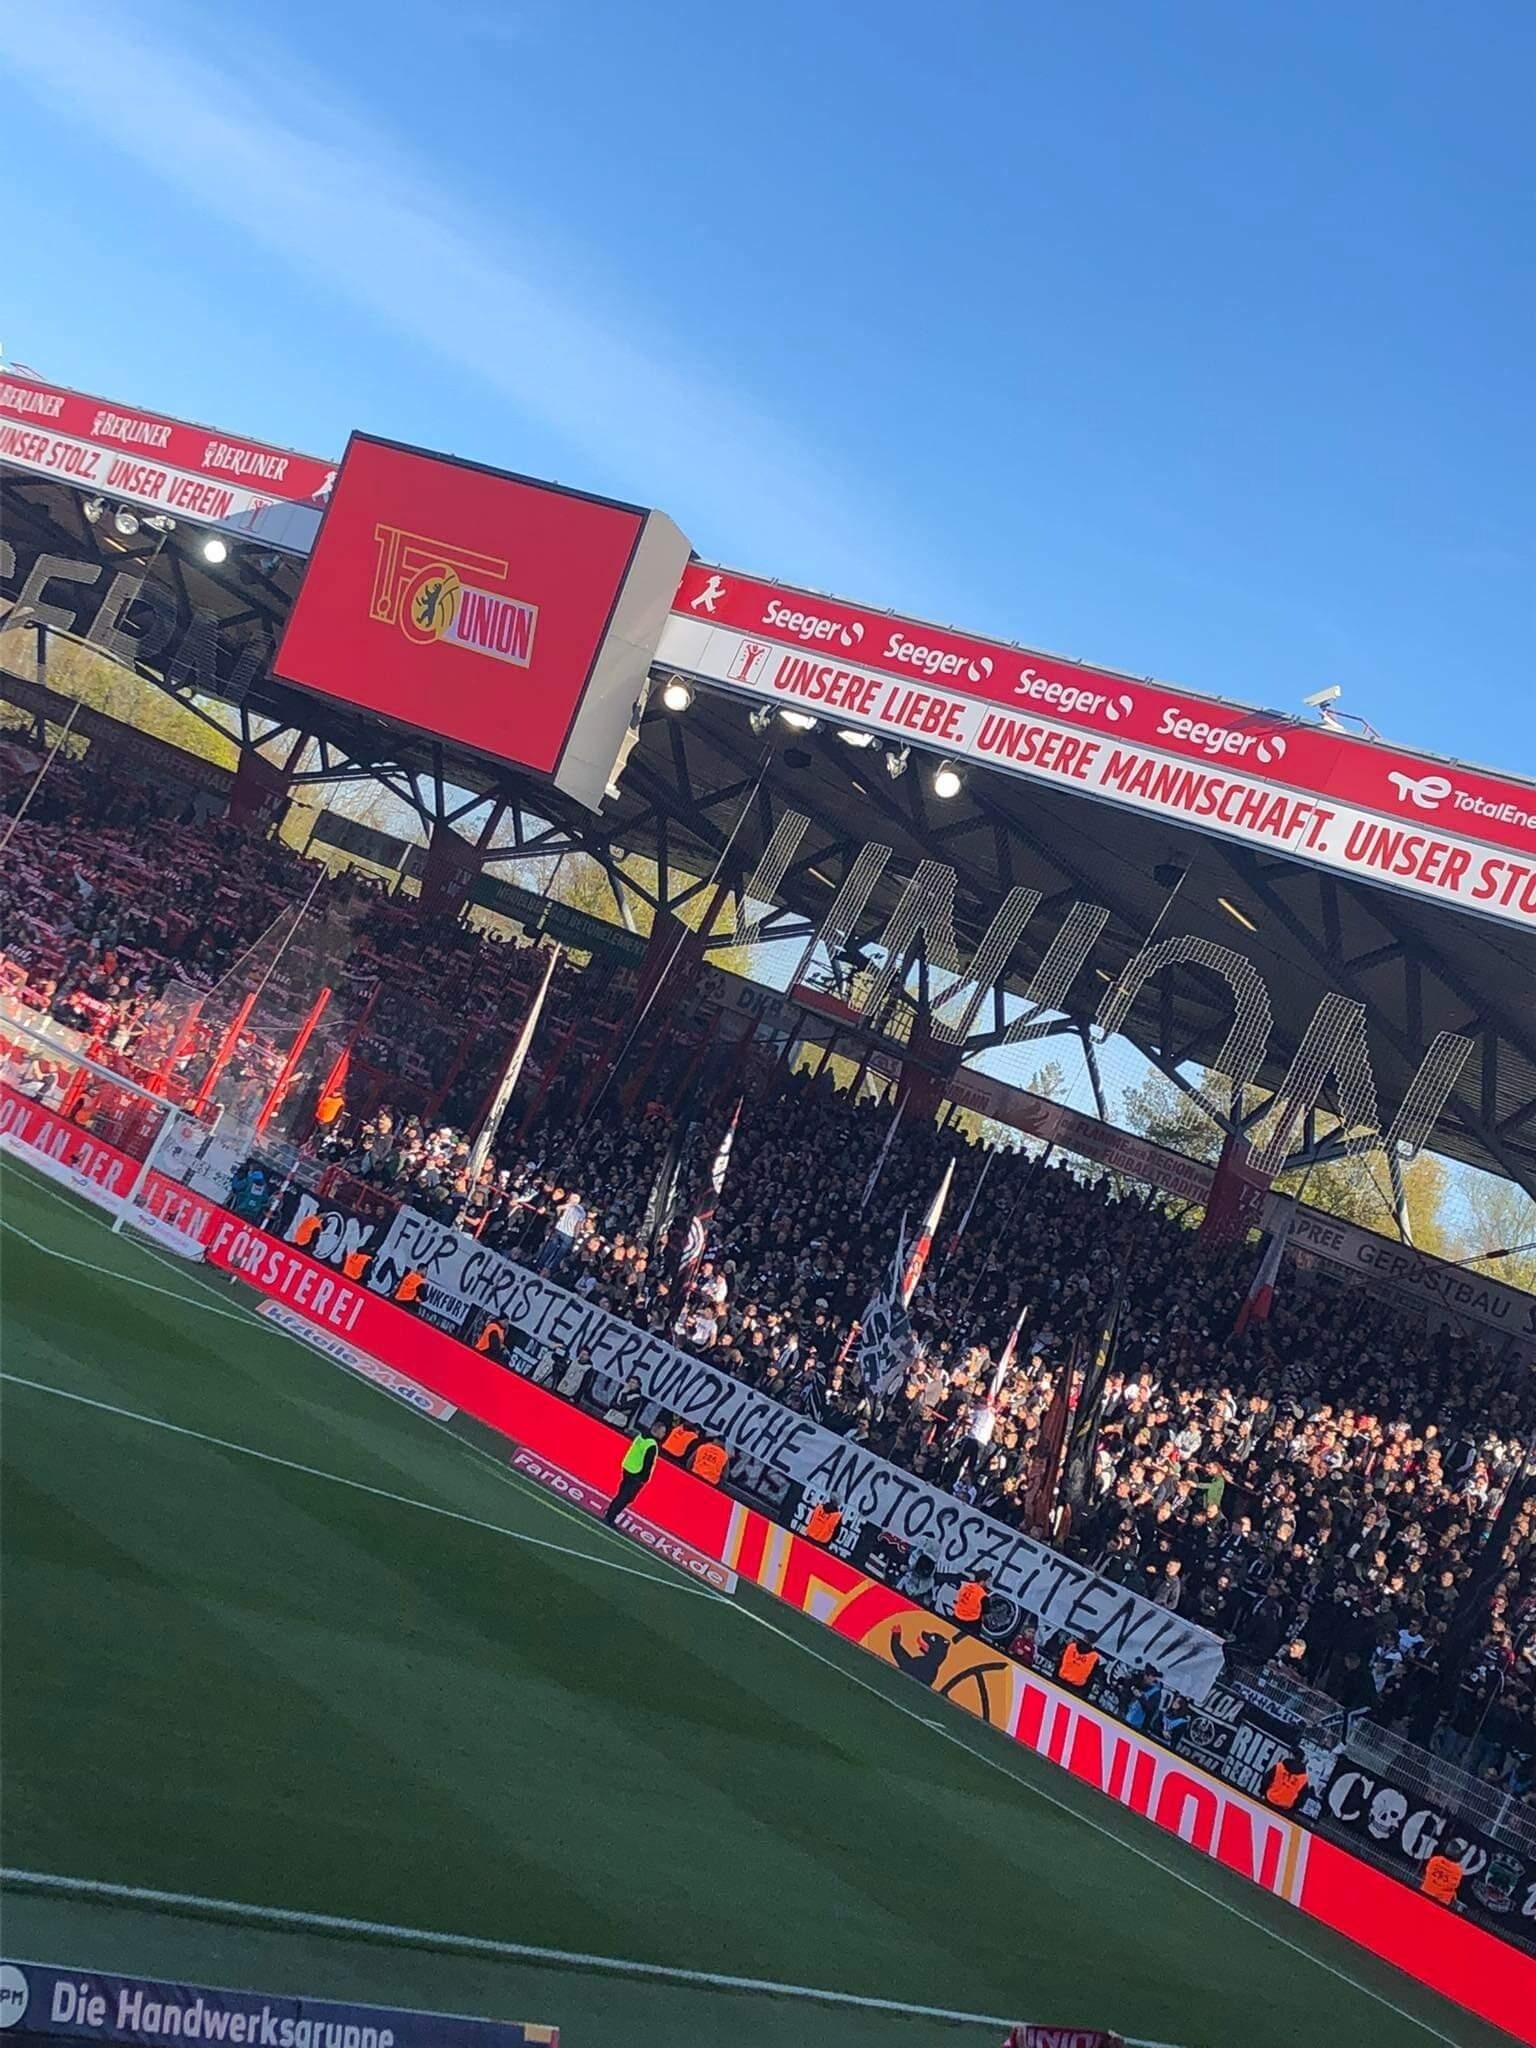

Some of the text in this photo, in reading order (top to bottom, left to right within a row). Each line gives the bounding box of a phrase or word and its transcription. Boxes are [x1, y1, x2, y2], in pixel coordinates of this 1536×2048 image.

[2, 384, 65, 418] BERLINER
[100, 413, 172, 448] BERLINER
[46, 441, 101, 479] STOLZ.
[211, 443, 289, 481] BERLINER
[105, 459, 236, 521] UNSER VEREIN.
[457, 590, 534, 660] UNION
[762, 599, 843, 641] Seeger
[884, 632, 968, 677] Seeger
[773, 655, 967, 742] UNSERE LIEBE.
[1013, 668, 1106, 715] Seeger
[1156, 707, 1257, 756] Seeger
[976, 714, 1101, 780] UNSERE
[1099, 750, 1336, 852] MANNSCHAFT.
[1343, 819, 1472, 892] UNSER
[33, 1121, 72, 1161] AN
[212, 1222, 365, 1332] FÖRSTEREI
[394, 1217, 459, 1275] FÜR
[1287, 1217, 1345, 1252] PREE
[266, 1305, 434, 1410] kfzteile24.de
[51, 1980, 106, 2027] Die
